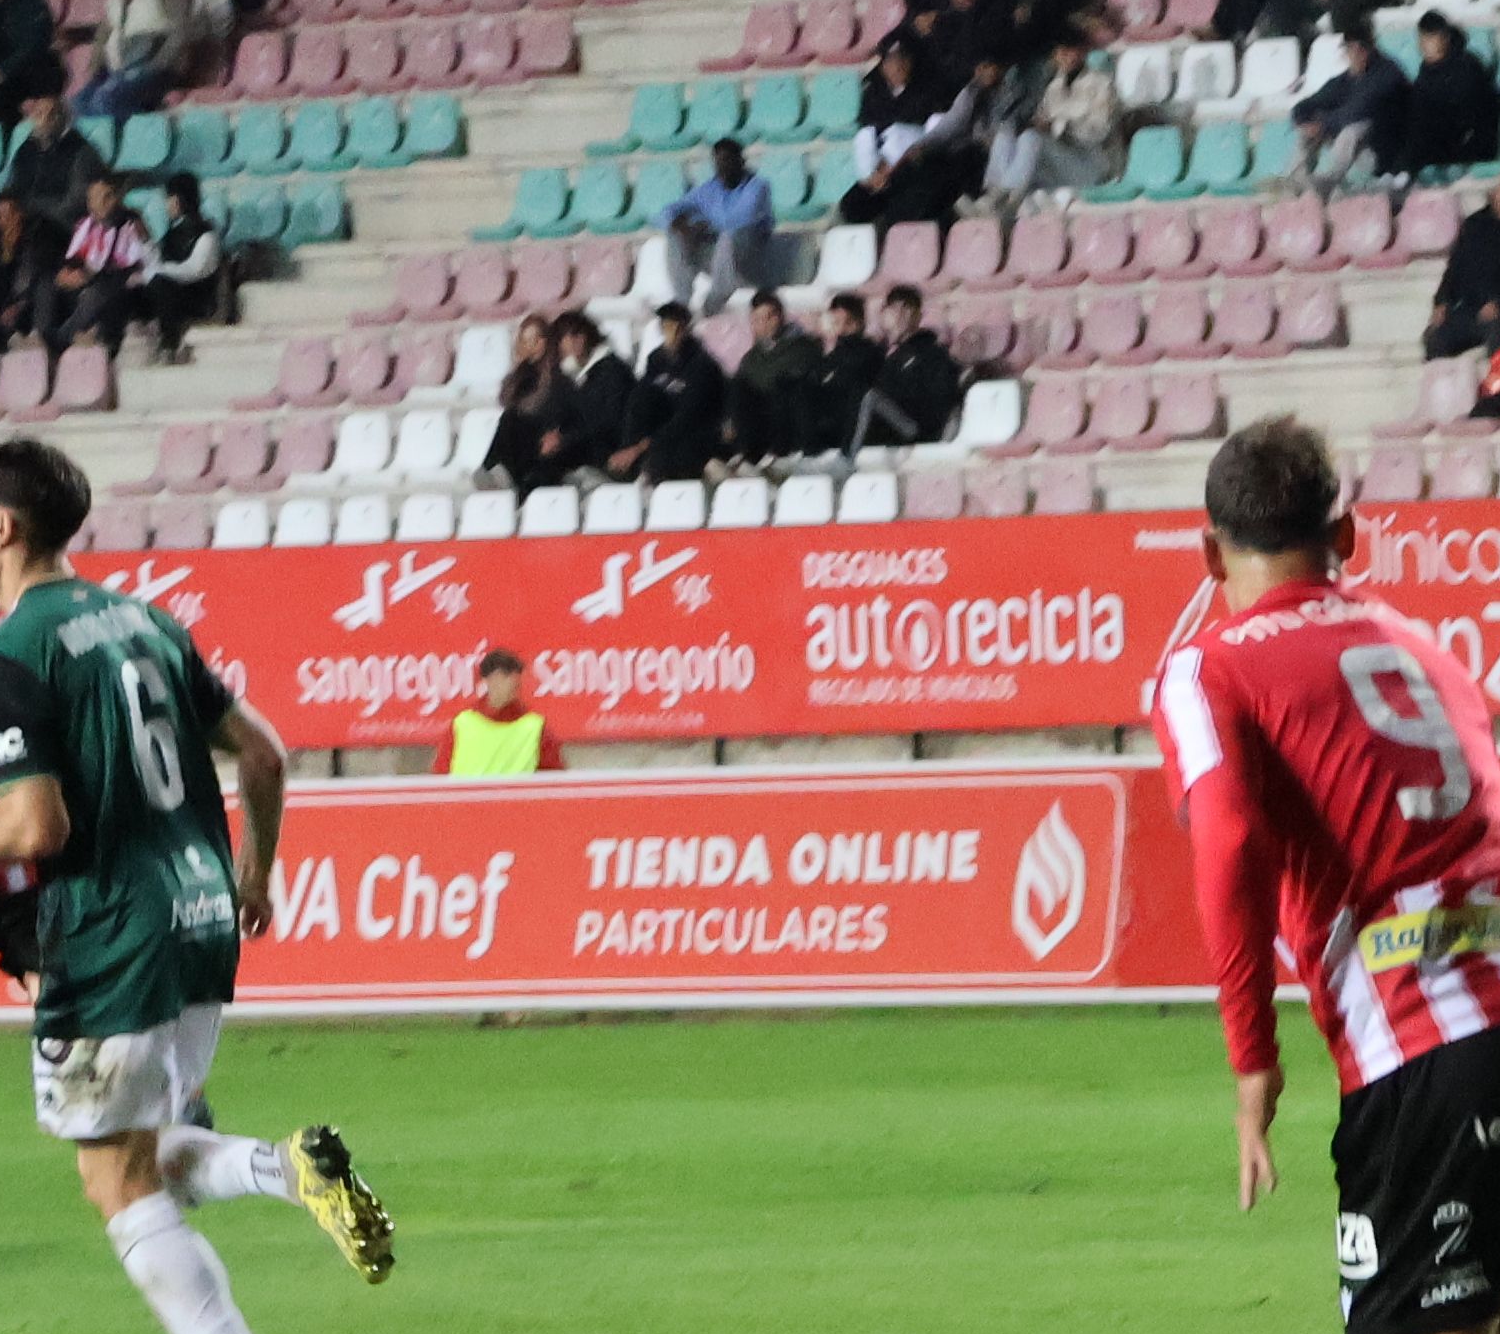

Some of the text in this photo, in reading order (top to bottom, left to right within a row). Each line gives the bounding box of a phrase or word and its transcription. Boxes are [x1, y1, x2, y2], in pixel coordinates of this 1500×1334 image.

[804, 587, 1125, 673] autorecicla
[120, 659, 186, 813] 6
[1340, 642, 1472, 822] 9
[355, 851, 516, 960] Chef
[586, 829, 981, 890] TIENDA ONLINE
[573, 903, 889, 958] PARTICULARES
